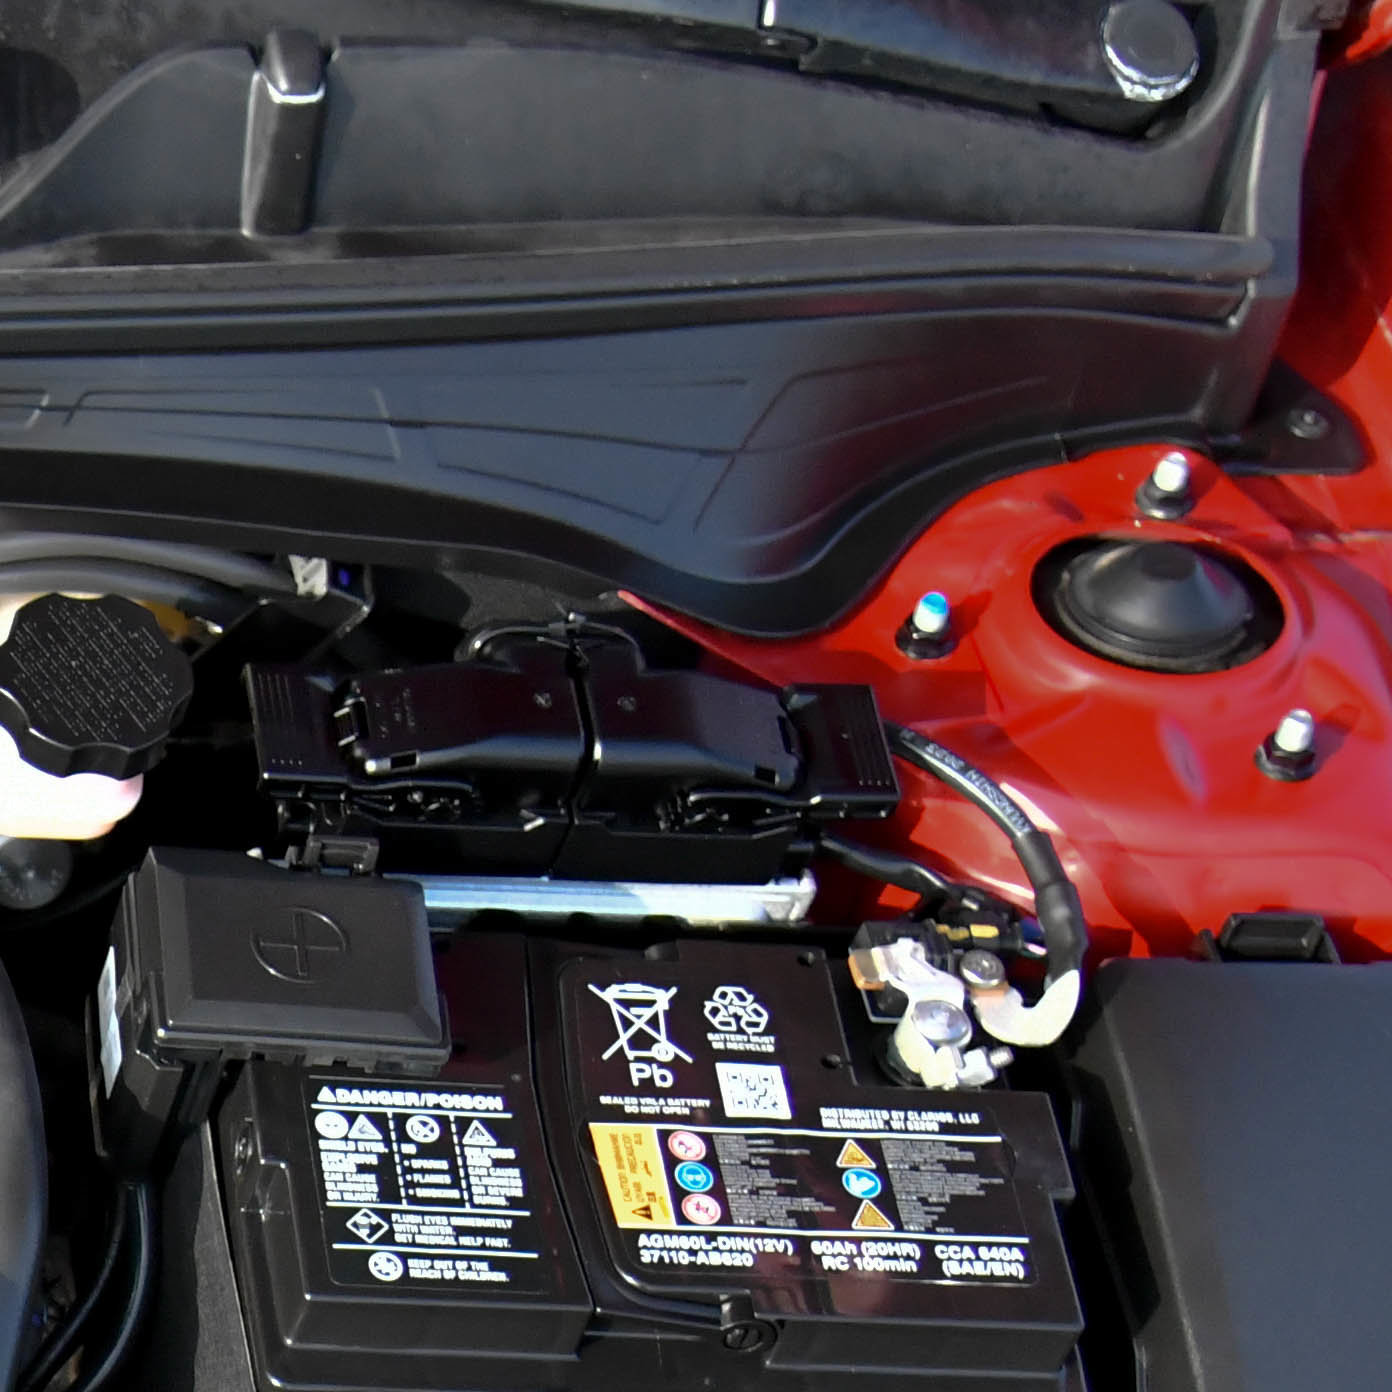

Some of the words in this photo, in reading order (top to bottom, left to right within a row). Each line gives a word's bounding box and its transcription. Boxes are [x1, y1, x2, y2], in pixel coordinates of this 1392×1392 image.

[629, 1062, 674, 1088] Pb
[336, 1088, 504, 1111] DANGER/POISON
[934, 1245, 976, 1260] CCA
[821, 1256, 850, 1271] RC
[854, 1256, 918, 1273] 100min
